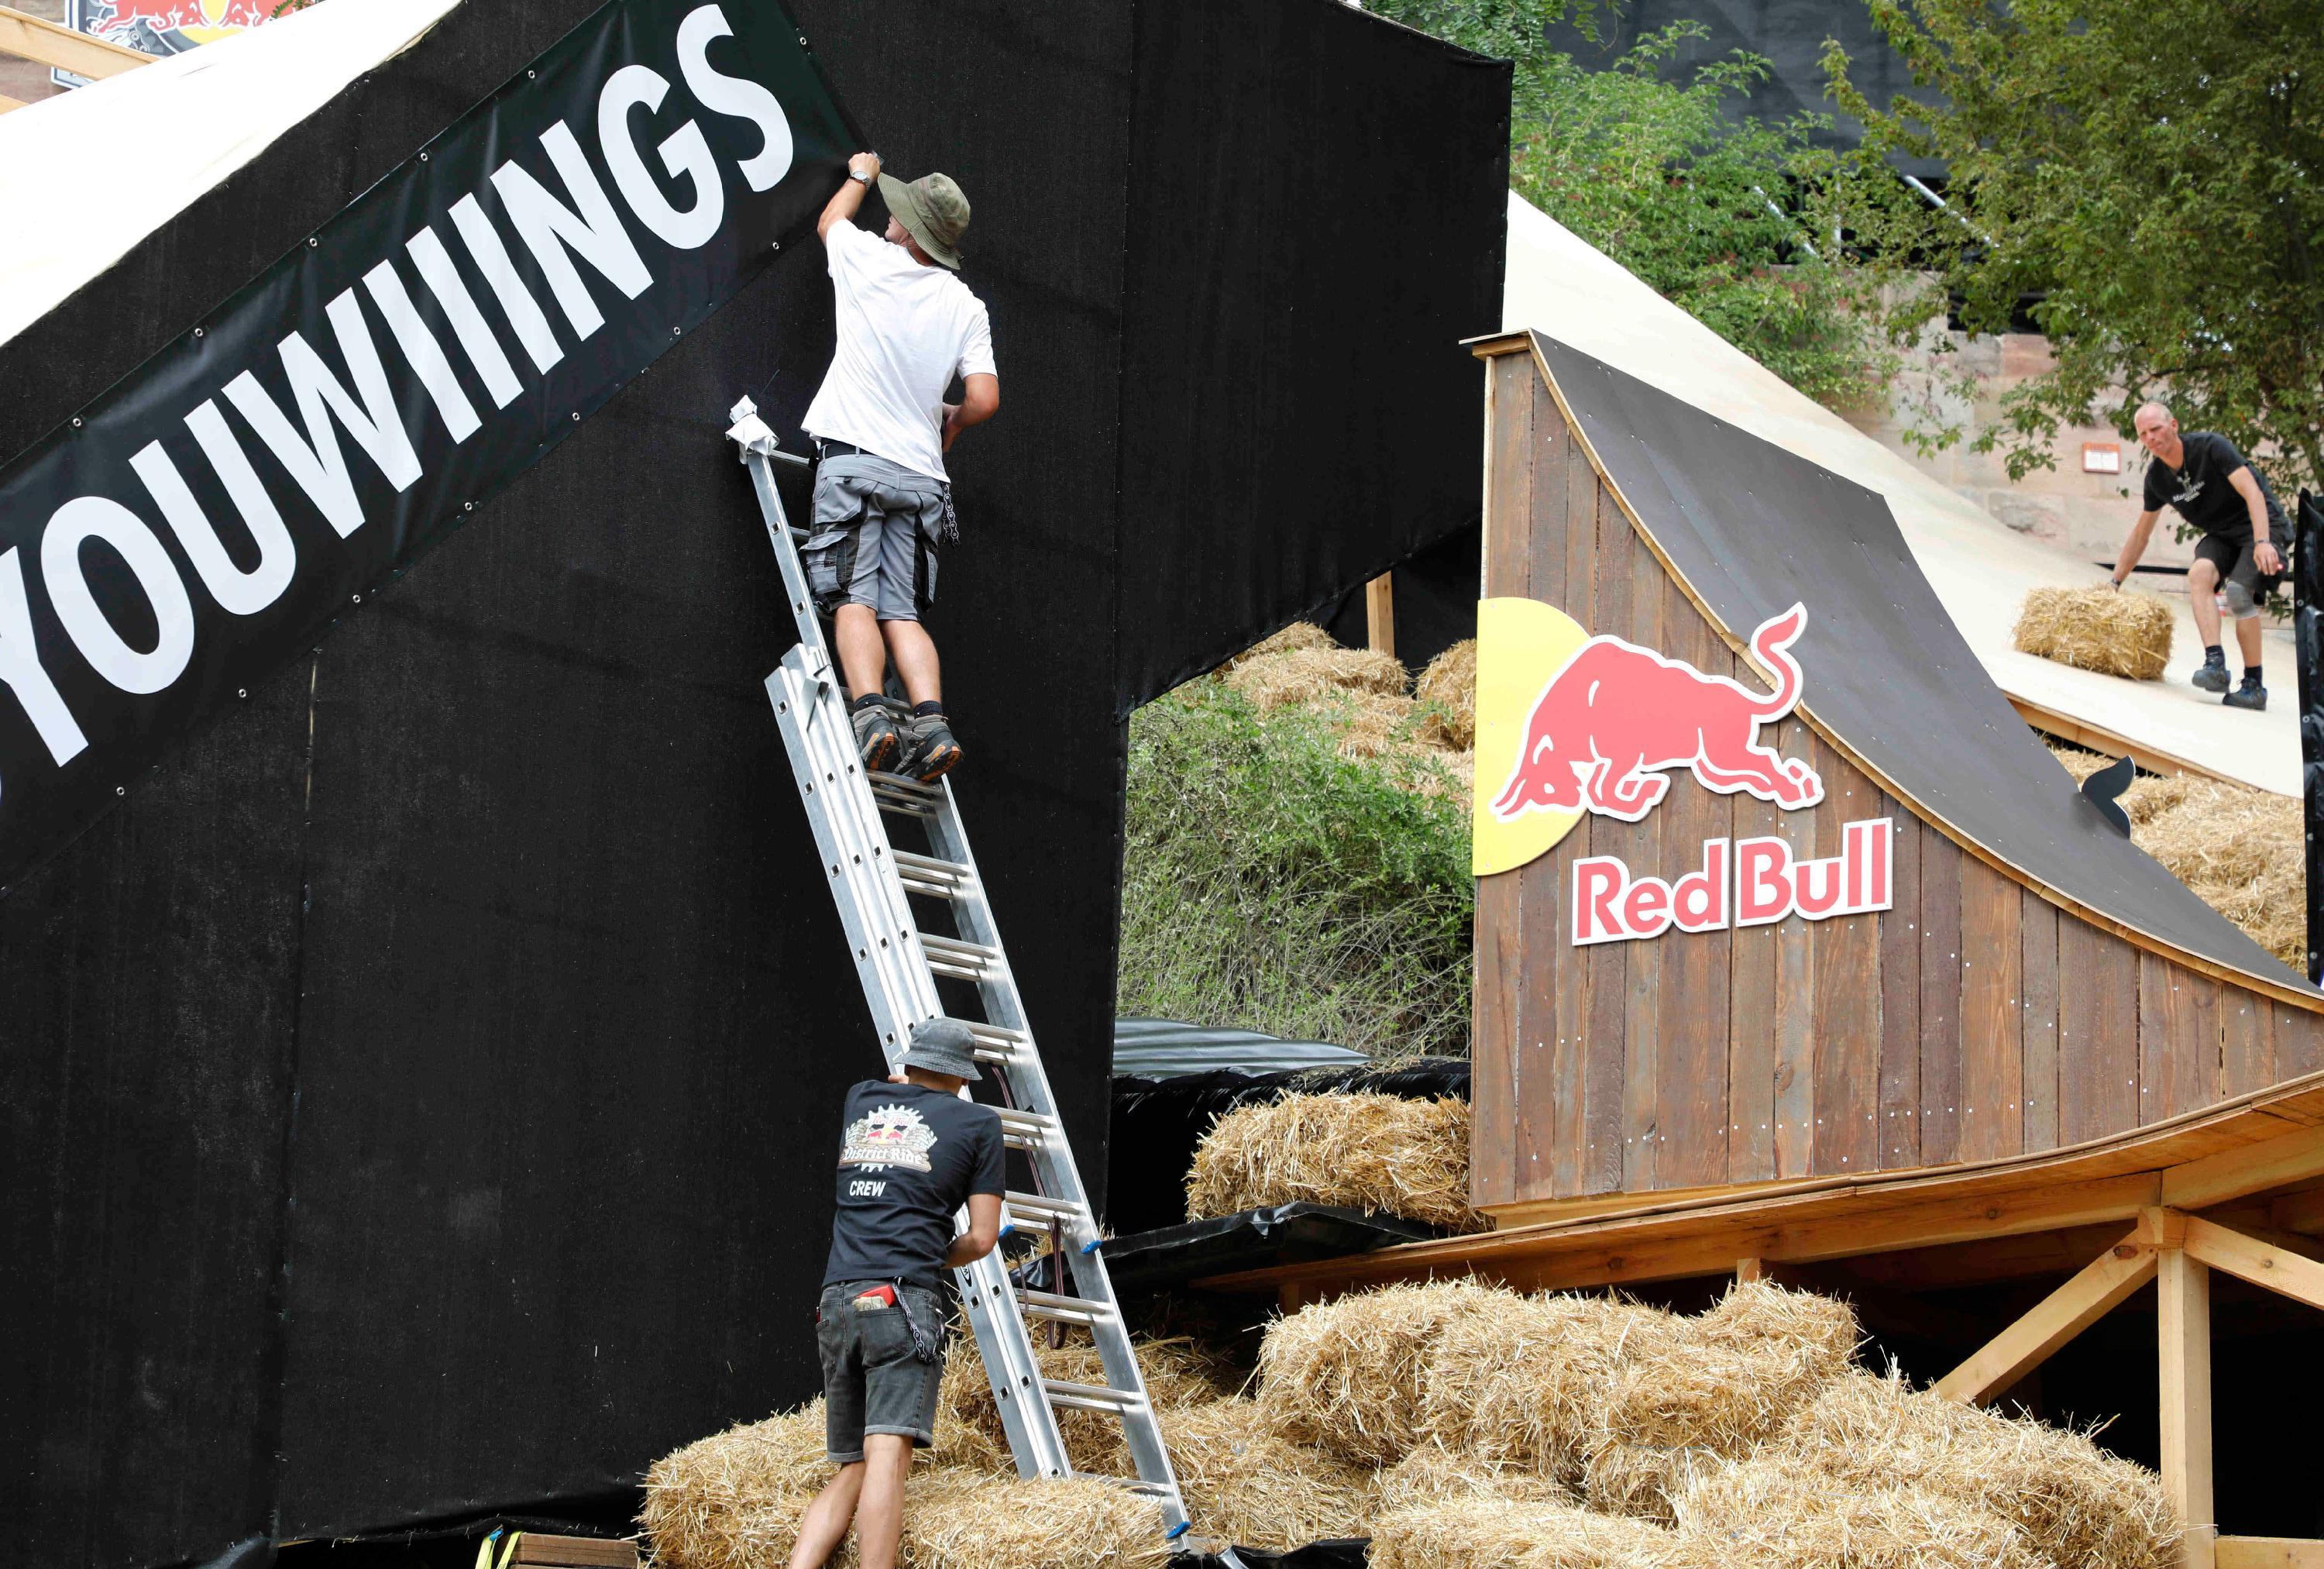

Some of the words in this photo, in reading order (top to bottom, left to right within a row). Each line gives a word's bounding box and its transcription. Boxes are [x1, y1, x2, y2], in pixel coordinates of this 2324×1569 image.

[1577, 844, 1722, 938] Red
[1740, 824, 1886, 920] Bull
[844, 1146, 889, 1161] District
[891, 1148, 923, 1164] Ride
[849, 1180, 886, 1196] CREW
